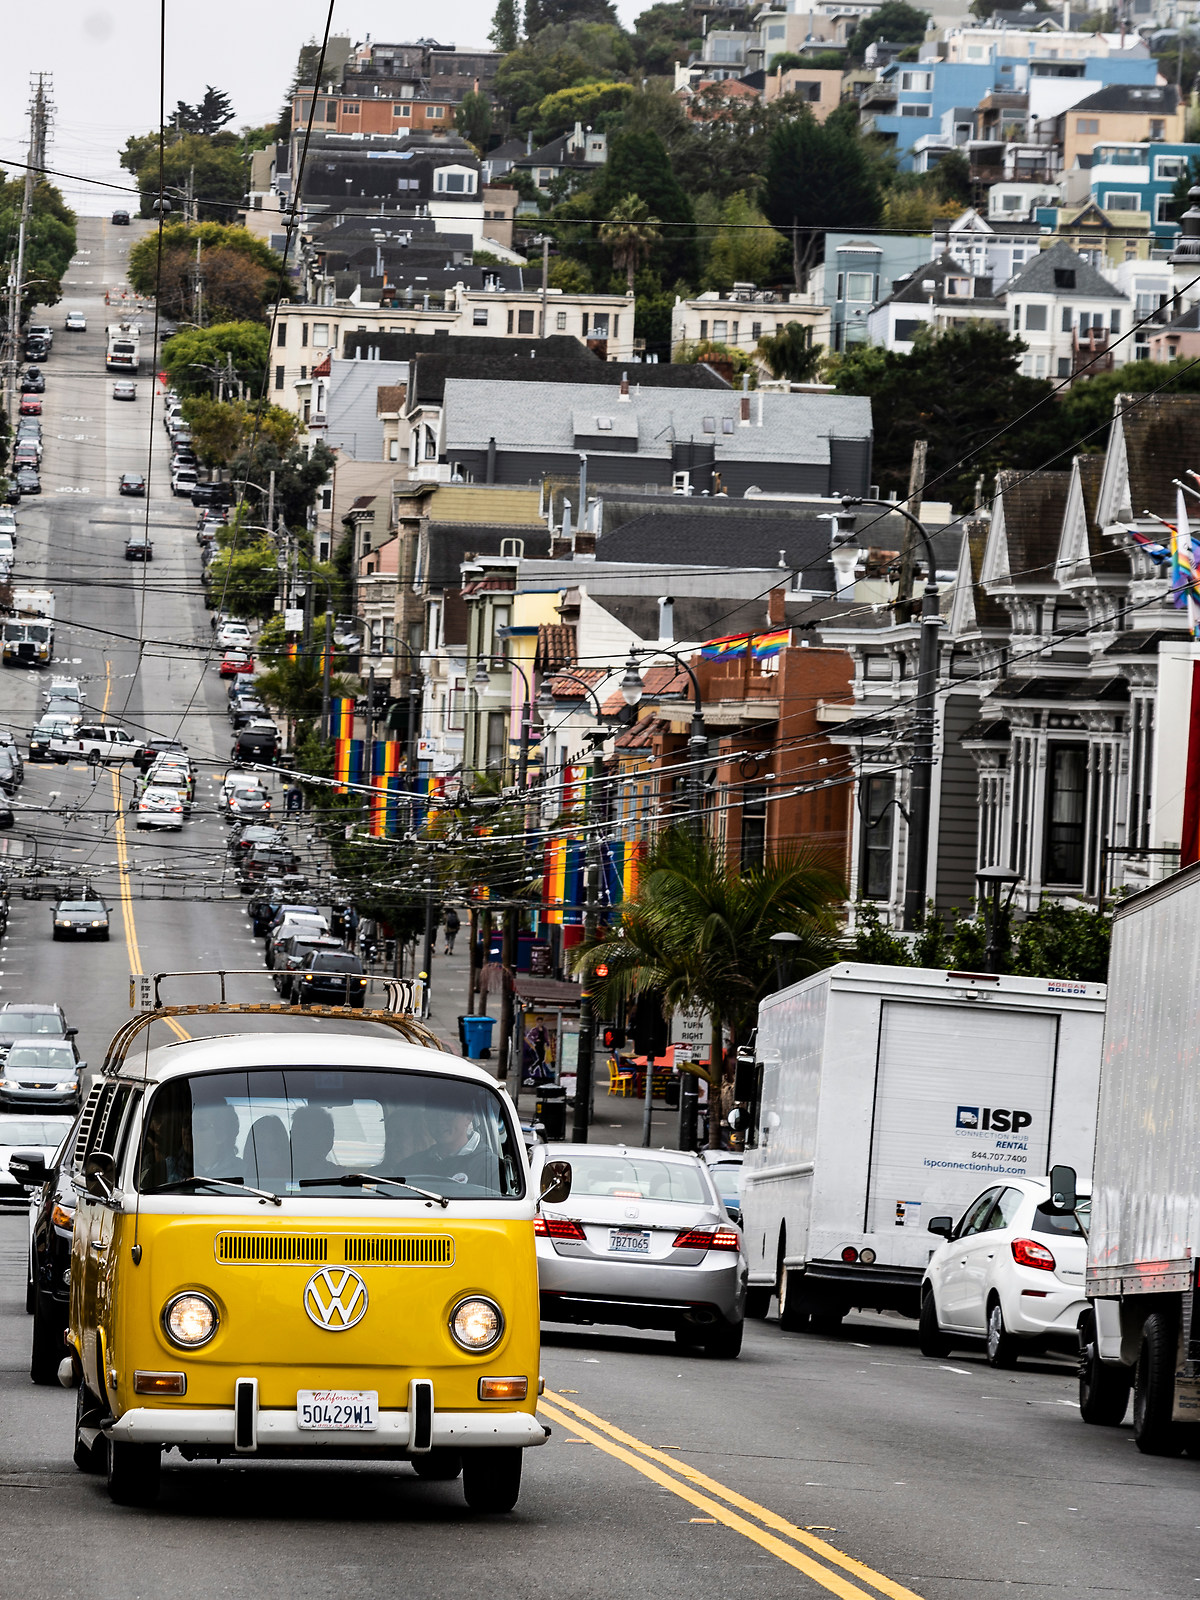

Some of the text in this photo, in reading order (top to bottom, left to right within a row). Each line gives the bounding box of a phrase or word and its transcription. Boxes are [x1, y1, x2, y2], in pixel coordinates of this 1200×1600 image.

[683, 1021, 704, 1029] TURN
[681, 1032, 704, 1040] RIGHT
[981, 1107, 1032, 1133] ISP
[955, 1129, 1010, 1140] CONNECTION
[995, 1140, 1029, 1151] RENTAL
[971, 1150, 1028, 1163] 844.707.7400
[923, 1157, 1027, 1175] ispconnectionhub.com
[611, 1236, 649, 1249] 7BZT065
[314, 1392, 364, 1404] California
[303, 1405, 373, 1424] 50429W1
